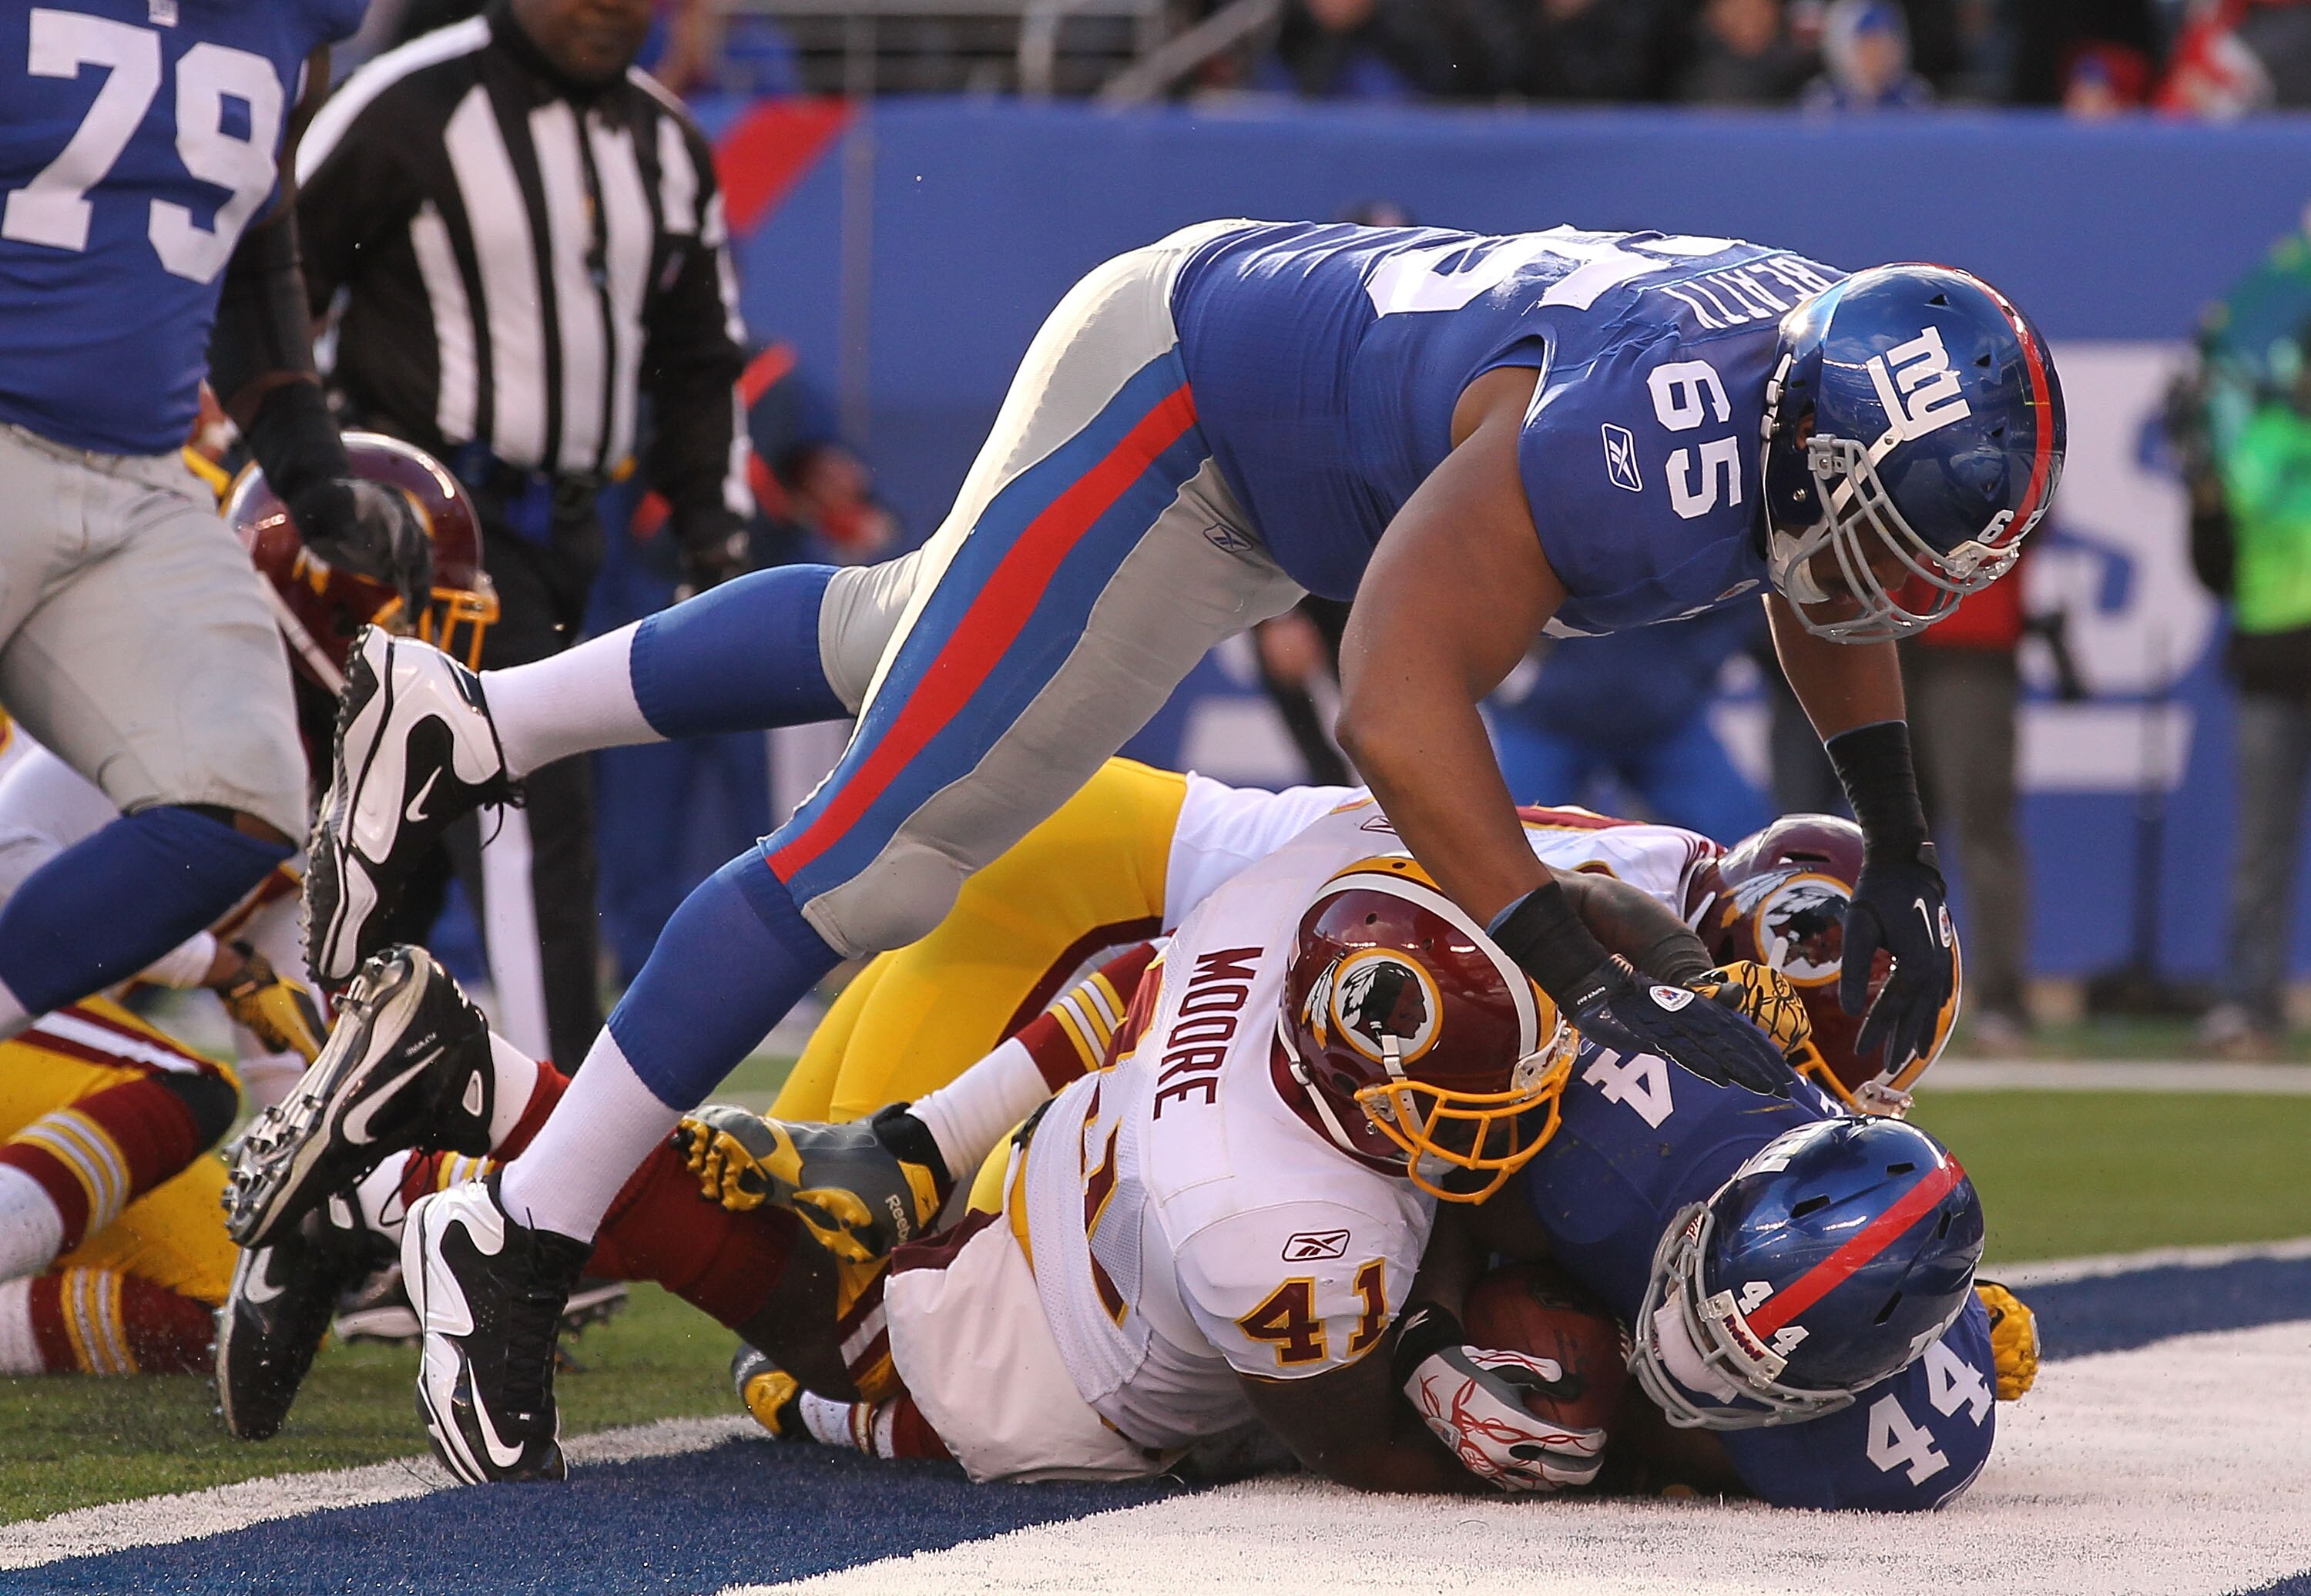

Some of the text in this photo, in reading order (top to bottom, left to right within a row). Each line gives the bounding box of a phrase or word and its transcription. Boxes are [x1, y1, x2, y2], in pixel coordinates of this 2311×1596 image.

[2, 7, 285, 284] 79
[1660, 256, 1833, 329] BEATTY
[1647, 360, 1742, 519] 65
[1153, 947, 1264, 1122] MOORE
[1233, 1256, 1390, 1367] 41
[1867, 1340, 1993, 1487] 44
